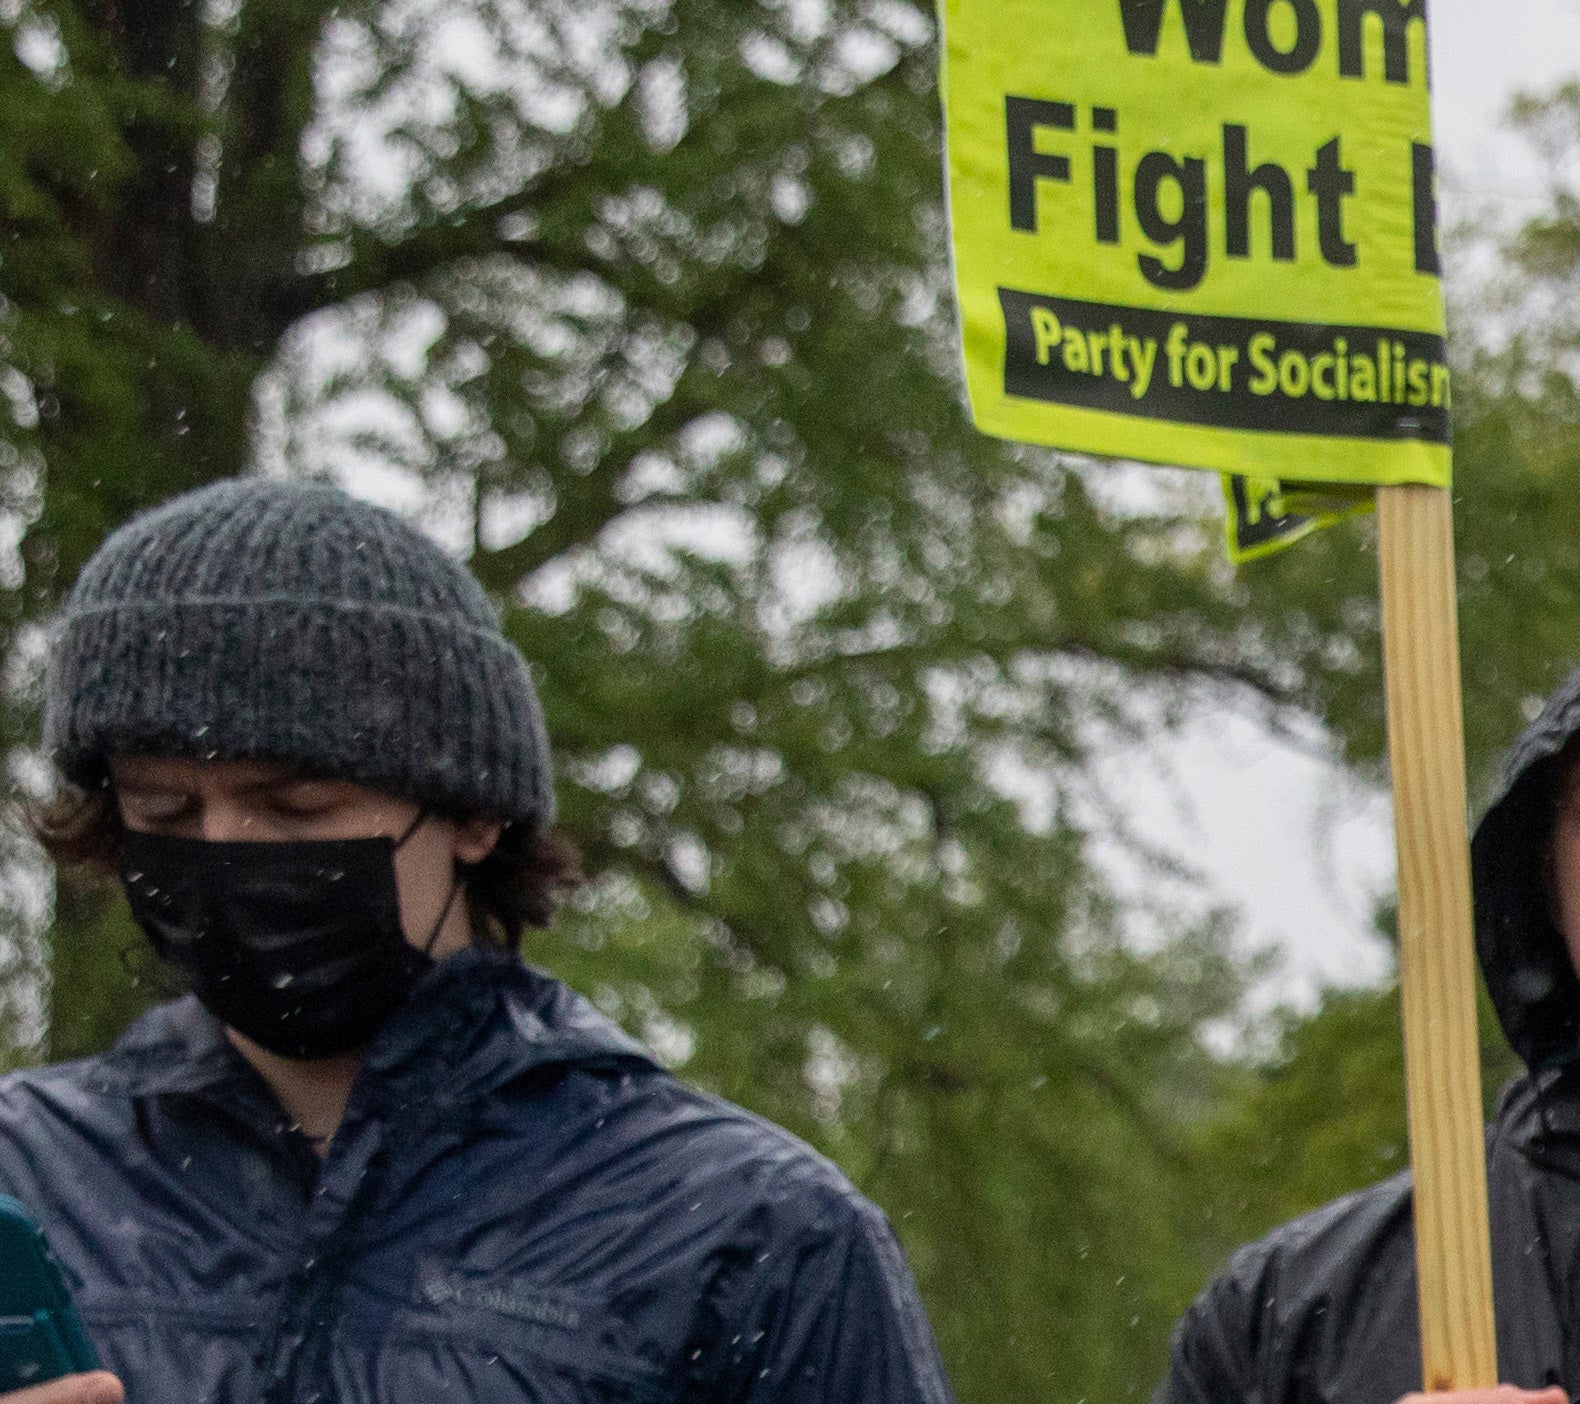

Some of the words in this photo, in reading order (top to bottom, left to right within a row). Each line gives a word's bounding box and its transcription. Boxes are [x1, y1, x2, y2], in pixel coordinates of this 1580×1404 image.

[1005, 95, 1357, 291] Fight
[1029, 305, 1157, 400] Party
[1165, 322, 1239, 393] for
